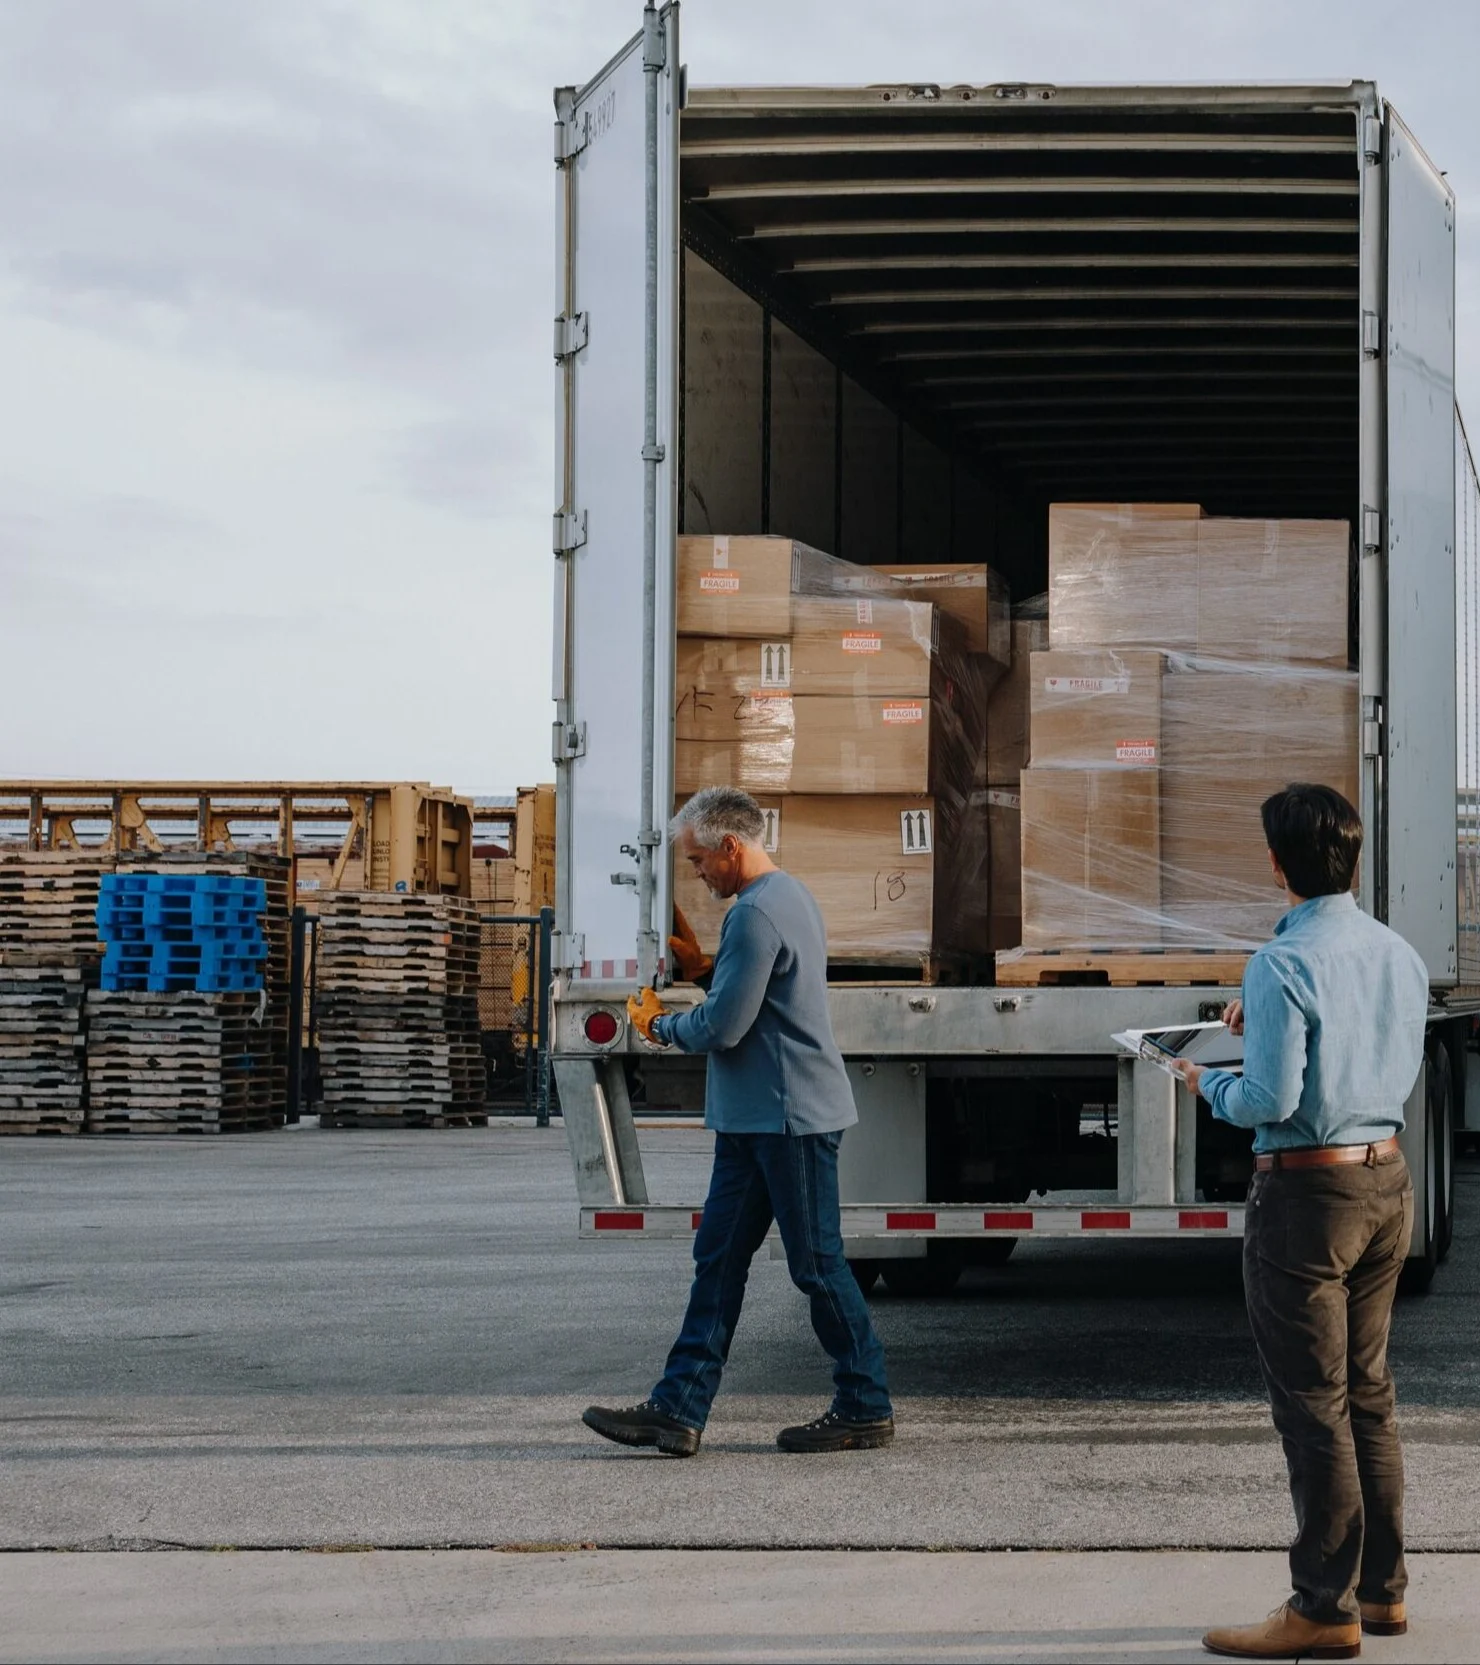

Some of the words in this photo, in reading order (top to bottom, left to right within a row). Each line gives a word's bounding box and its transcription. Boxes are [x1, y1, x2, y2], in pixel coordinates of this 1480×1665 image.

[703, 579, 738, 588] FRAGILE
[845, 639, 880, 649] FRAGILE
[1069, 679, 1104, 689] FRAGILE
[886, 709, 921, 719] FRAGILE
[1119, 748, 1154, 757] FRAGILE
[874, 870, 906, 911] 18
